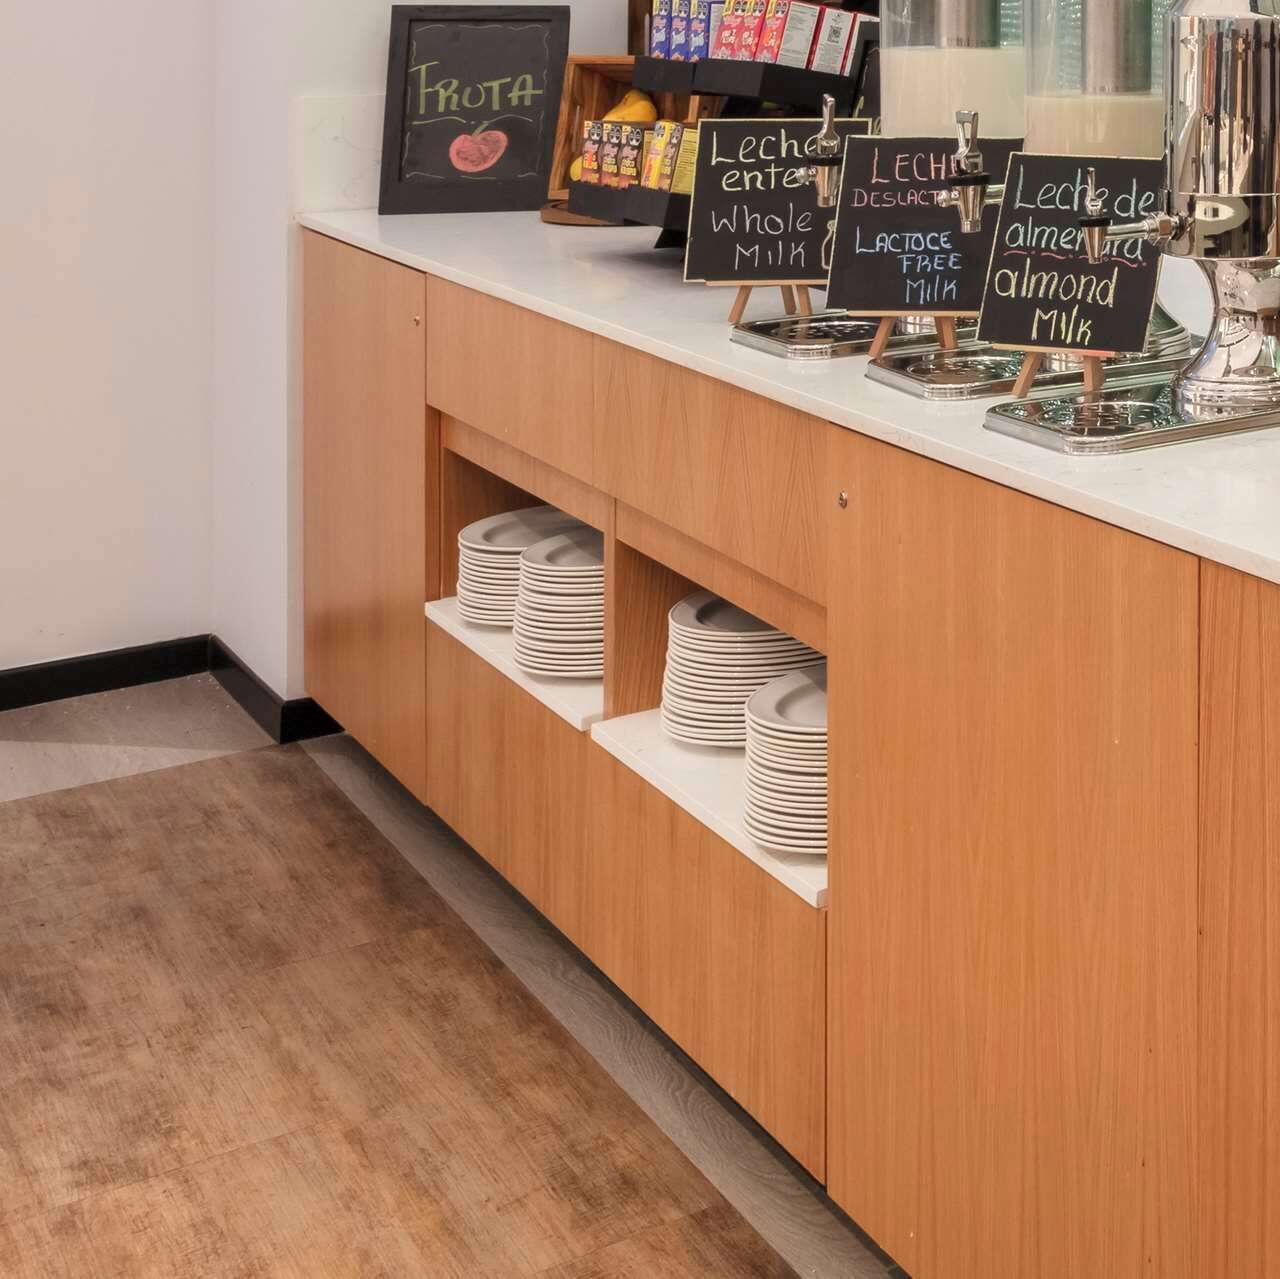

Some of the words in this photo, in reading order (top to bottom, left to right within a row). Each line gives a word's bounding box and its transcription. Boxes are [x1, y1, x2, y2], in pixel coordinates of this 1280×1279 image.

[408, 61, 543, 114] FRUTA
[1114, 177, 1155, 218] de
[897, 253, 963, 274] FREE
[994, 257, 1119, 308] almond
